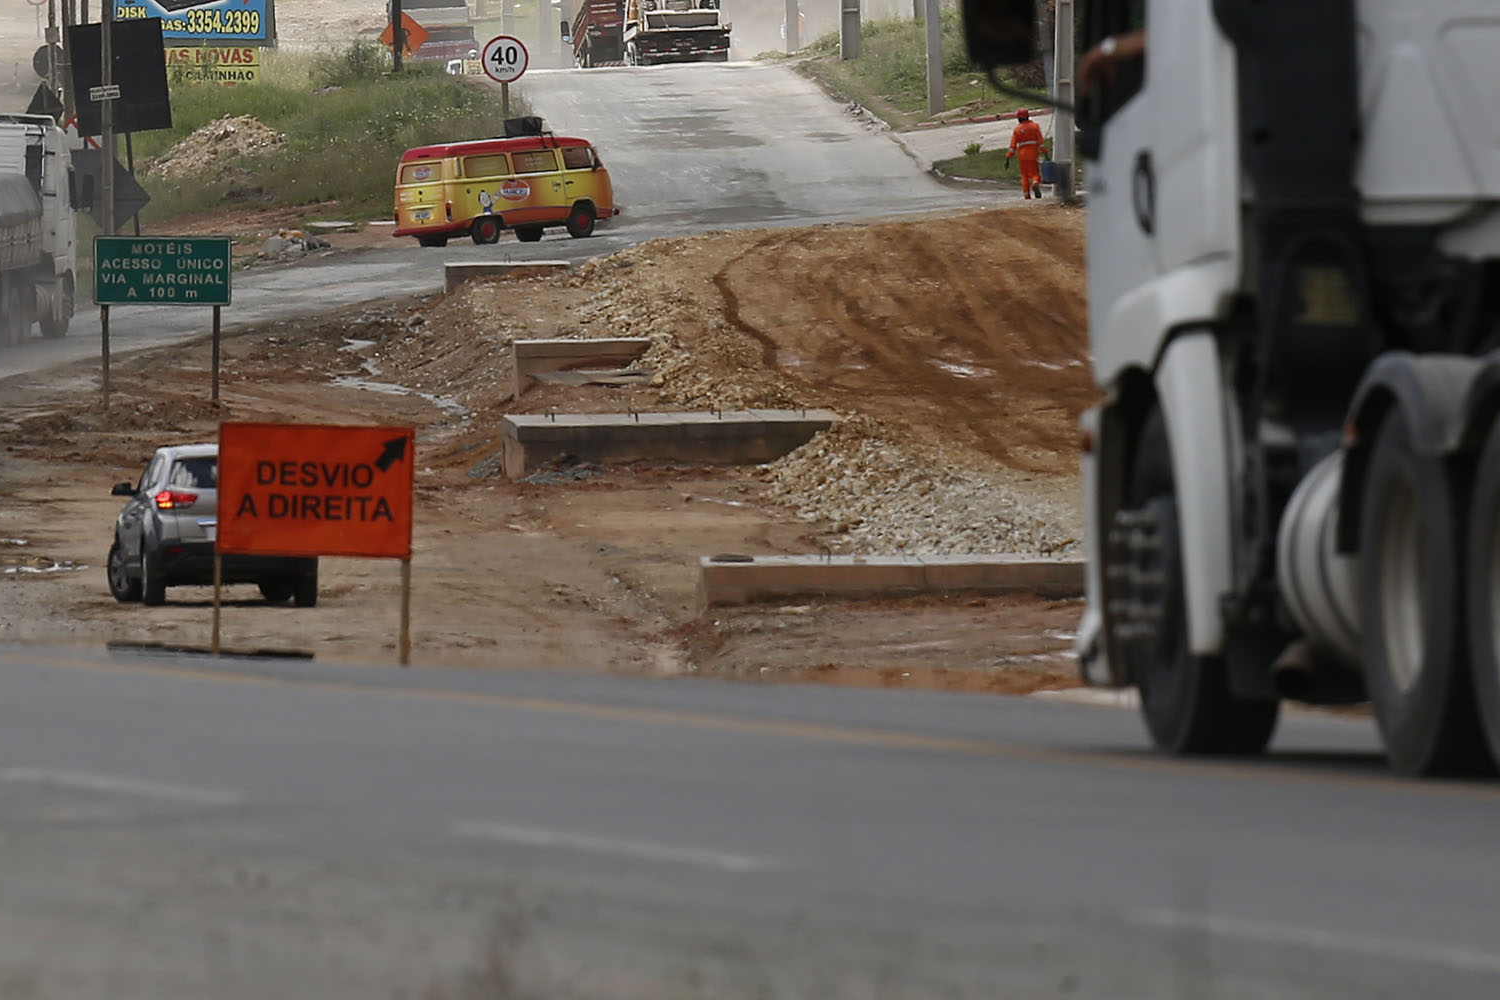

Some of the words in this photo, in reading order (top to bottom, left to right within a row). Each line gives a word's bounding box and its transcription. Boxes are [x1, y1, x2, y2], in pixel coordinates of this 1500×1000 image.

[117, 6, 146, 19] DISK
[187, 9, 260, 33] 3354.2399
[491, 46, 518, 65] 40
[131, 242, 193, 255] MOTÉIS
[101, 258, 161, 269] ACESSO
[176, 257, 224, 269] ÚNICO
[102, 273, 127, 284] VIA
[143, 273, 223, 285] MARGINAL
[127, 287, 138, 298] A
[149, 287, 175, 298] 100
[185, 289, 197, 298] m
[257, 461, 374, 488] DESVIO
[236, 492, 258, 518] A
[268, 494, 394, 522] DIREITA
